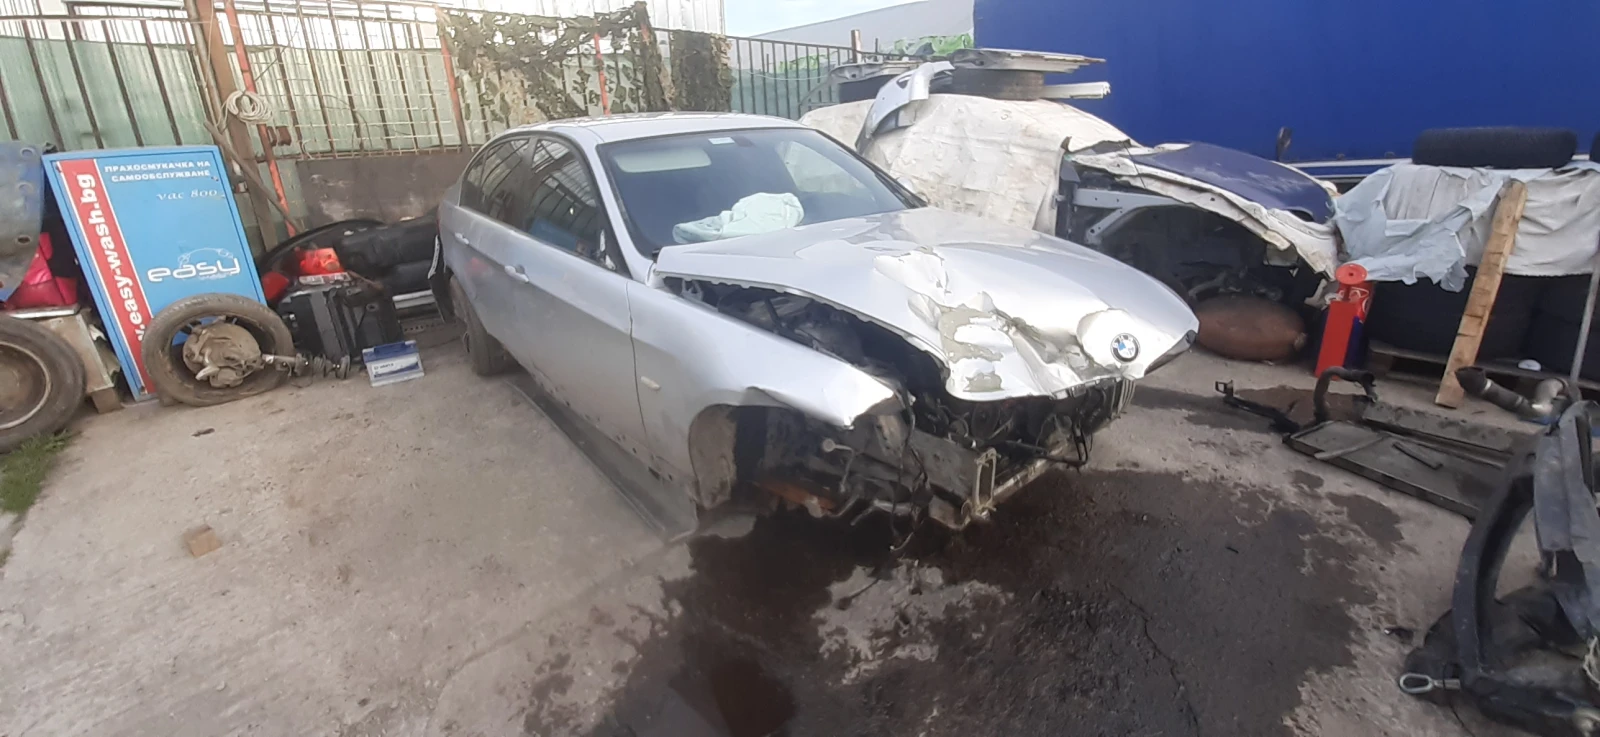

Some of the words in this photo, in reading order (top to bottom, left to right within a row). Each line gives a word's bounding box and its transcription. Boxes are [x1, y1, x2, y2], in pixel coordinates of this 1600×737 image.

[104, 161, 195, 173] ПРАХОСМУКАЧКА
[196, 160, 211, 168] НА
[111, 169, 211, 182] САМООБСЛУЖВАНЕ
[147, 257, 241, 282] easy
